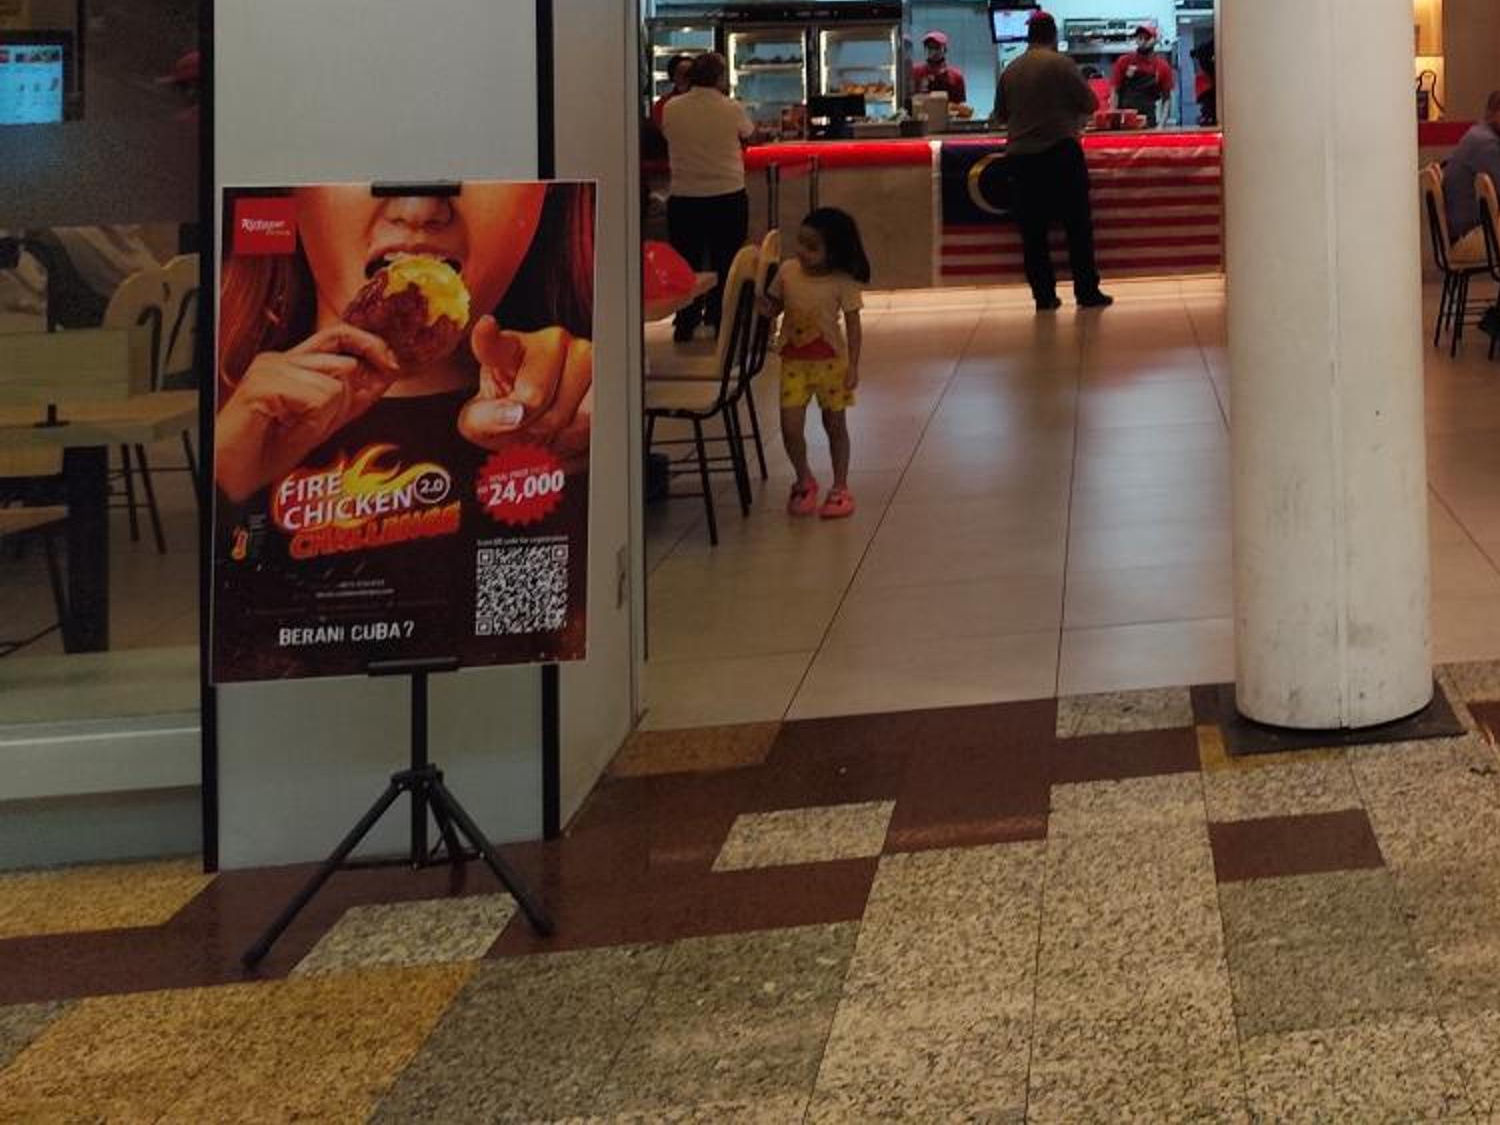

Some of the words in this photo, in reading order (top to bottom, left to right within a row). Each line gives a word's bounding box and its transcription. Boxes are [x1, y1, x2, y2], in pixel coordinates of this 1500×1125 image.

[280, 473, 342, 506] FIRE
[283, 484, 414, 530] CHICKEN
[420, 478, 445, 494] 2.0
[488, 469, 565, 507] 24,000
[278, 626, 345, 646] BERANI
